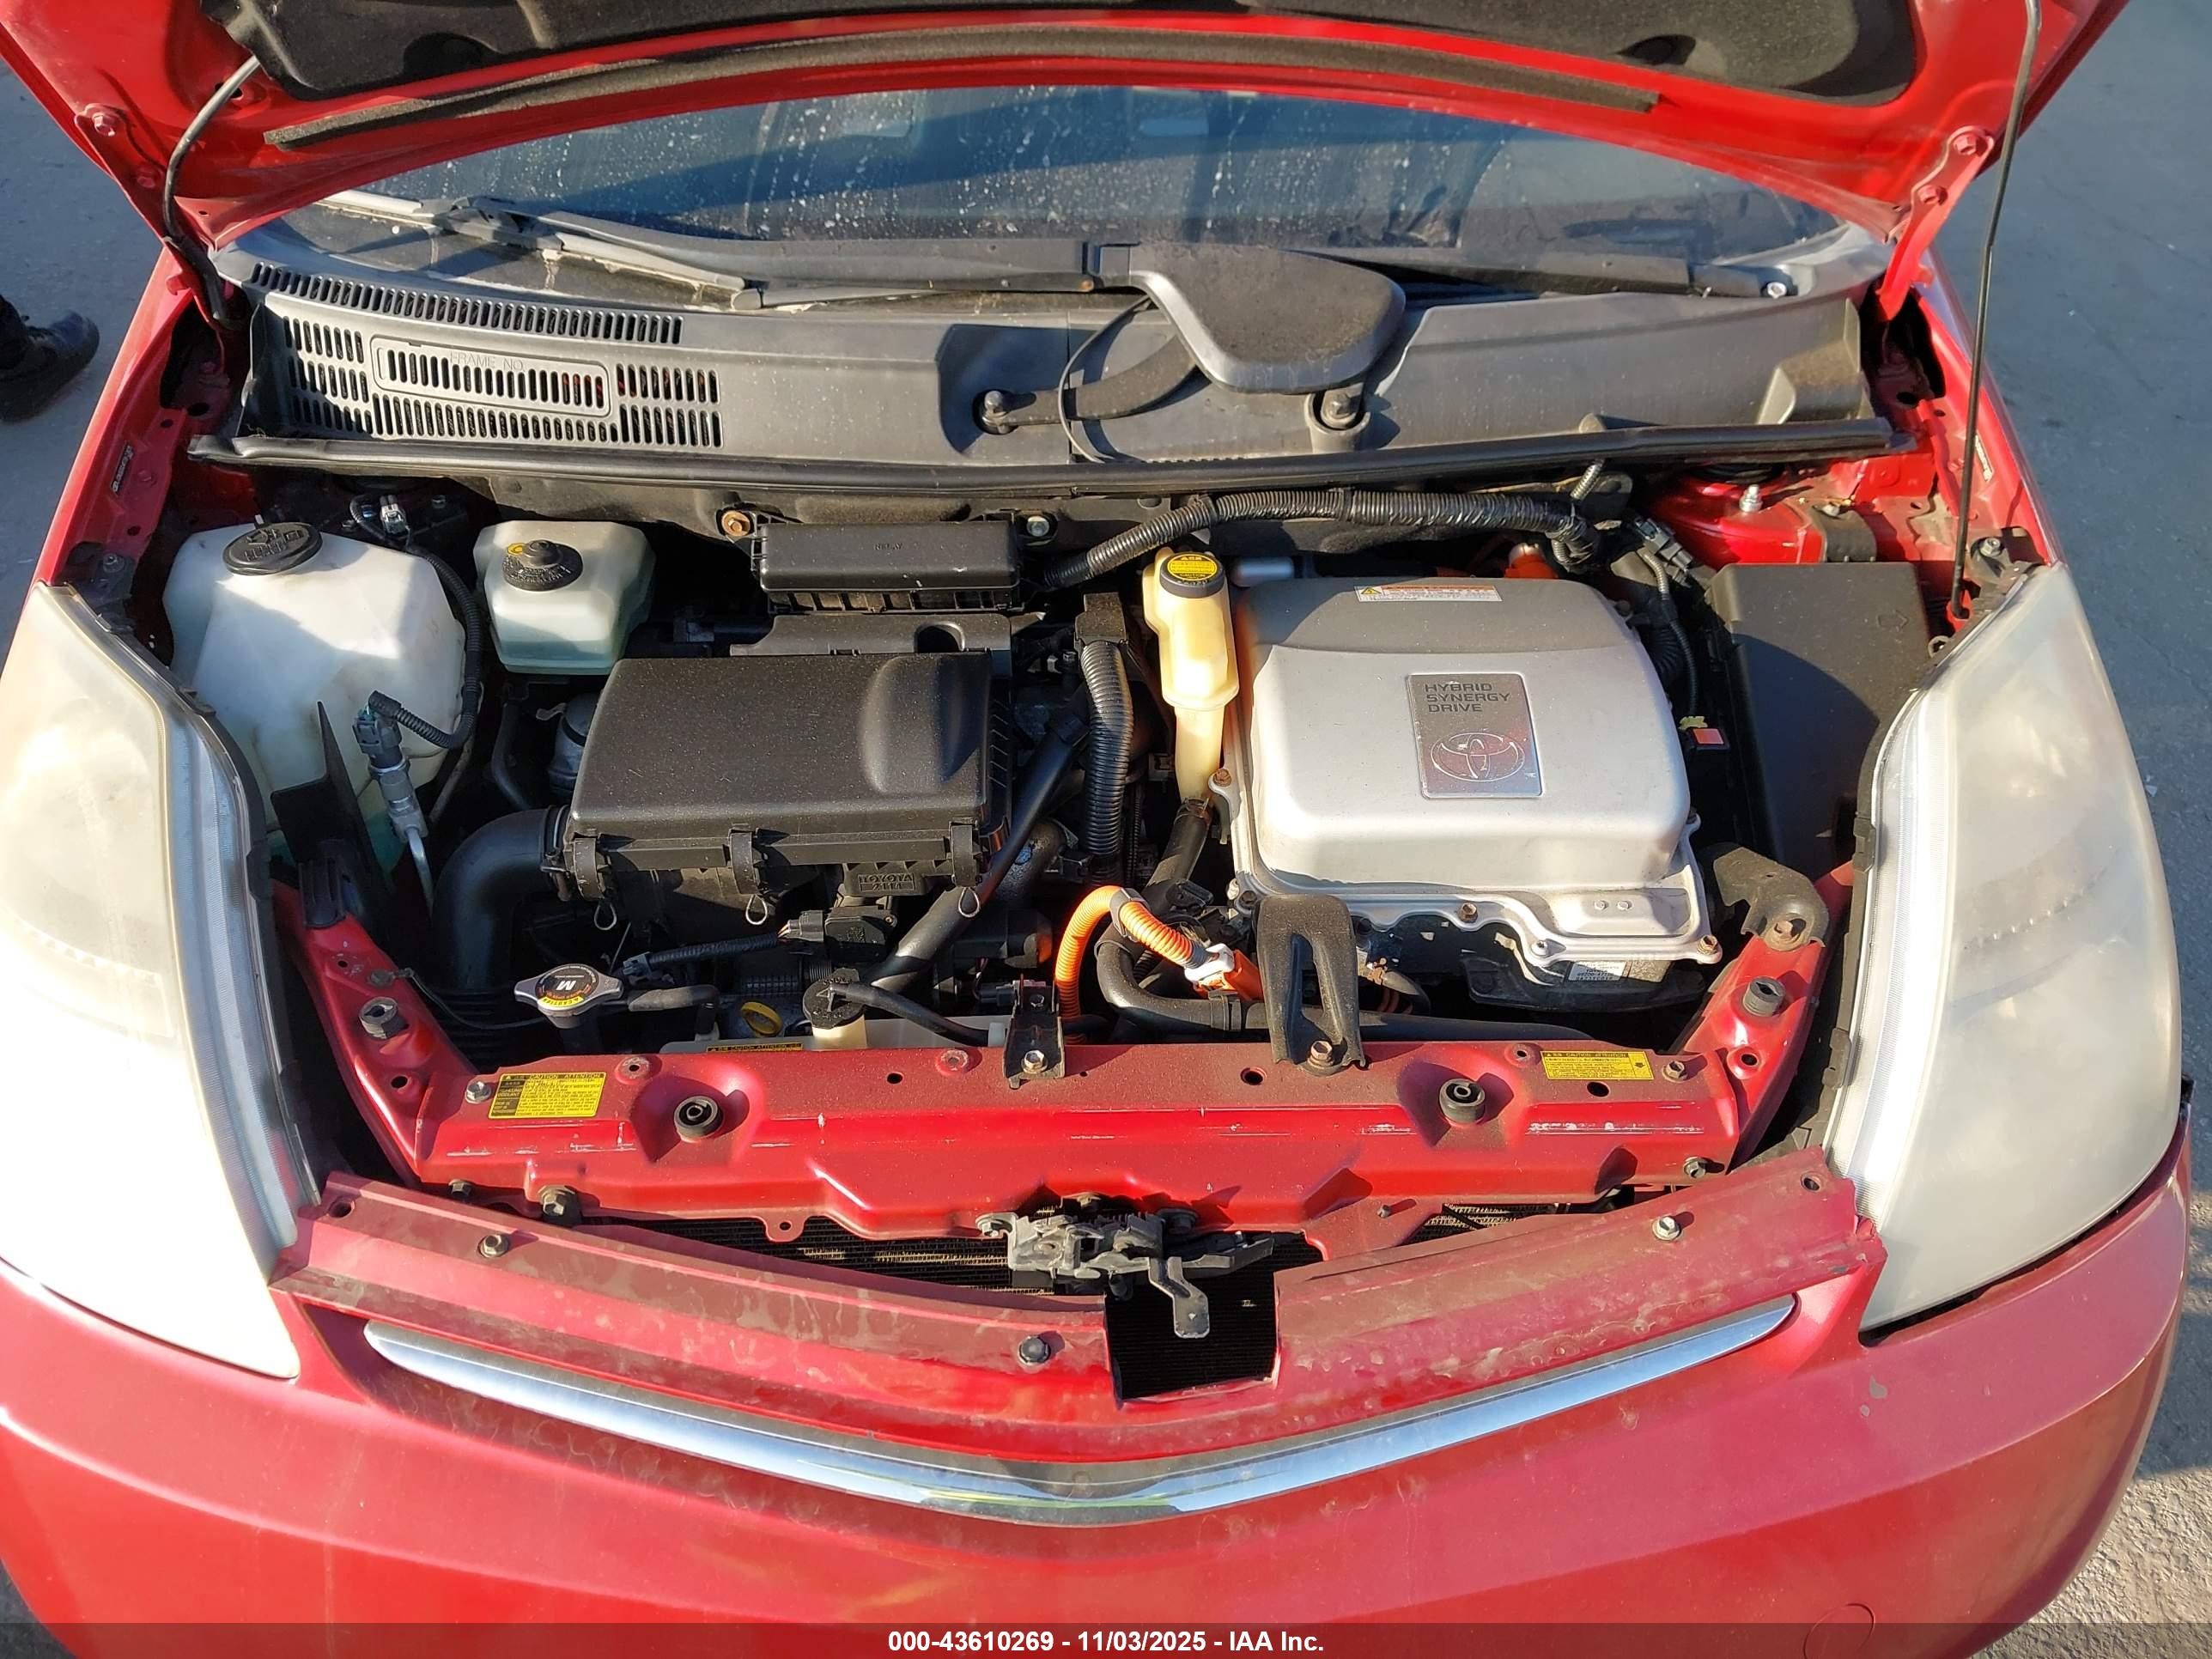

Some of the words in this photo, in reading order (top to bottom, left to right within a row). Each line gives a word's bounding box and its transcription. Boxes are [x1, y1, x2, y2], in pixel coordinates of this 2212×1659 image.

[450, 350, 495, 368] FRAME
[1425, 683, 1492, 692] HYBRID
[1426, 692, 1510, 702] SYNERGY
[1428, 703, 1483, 713] DRIVE
[859, 874, 913, 883] TOYOTA
